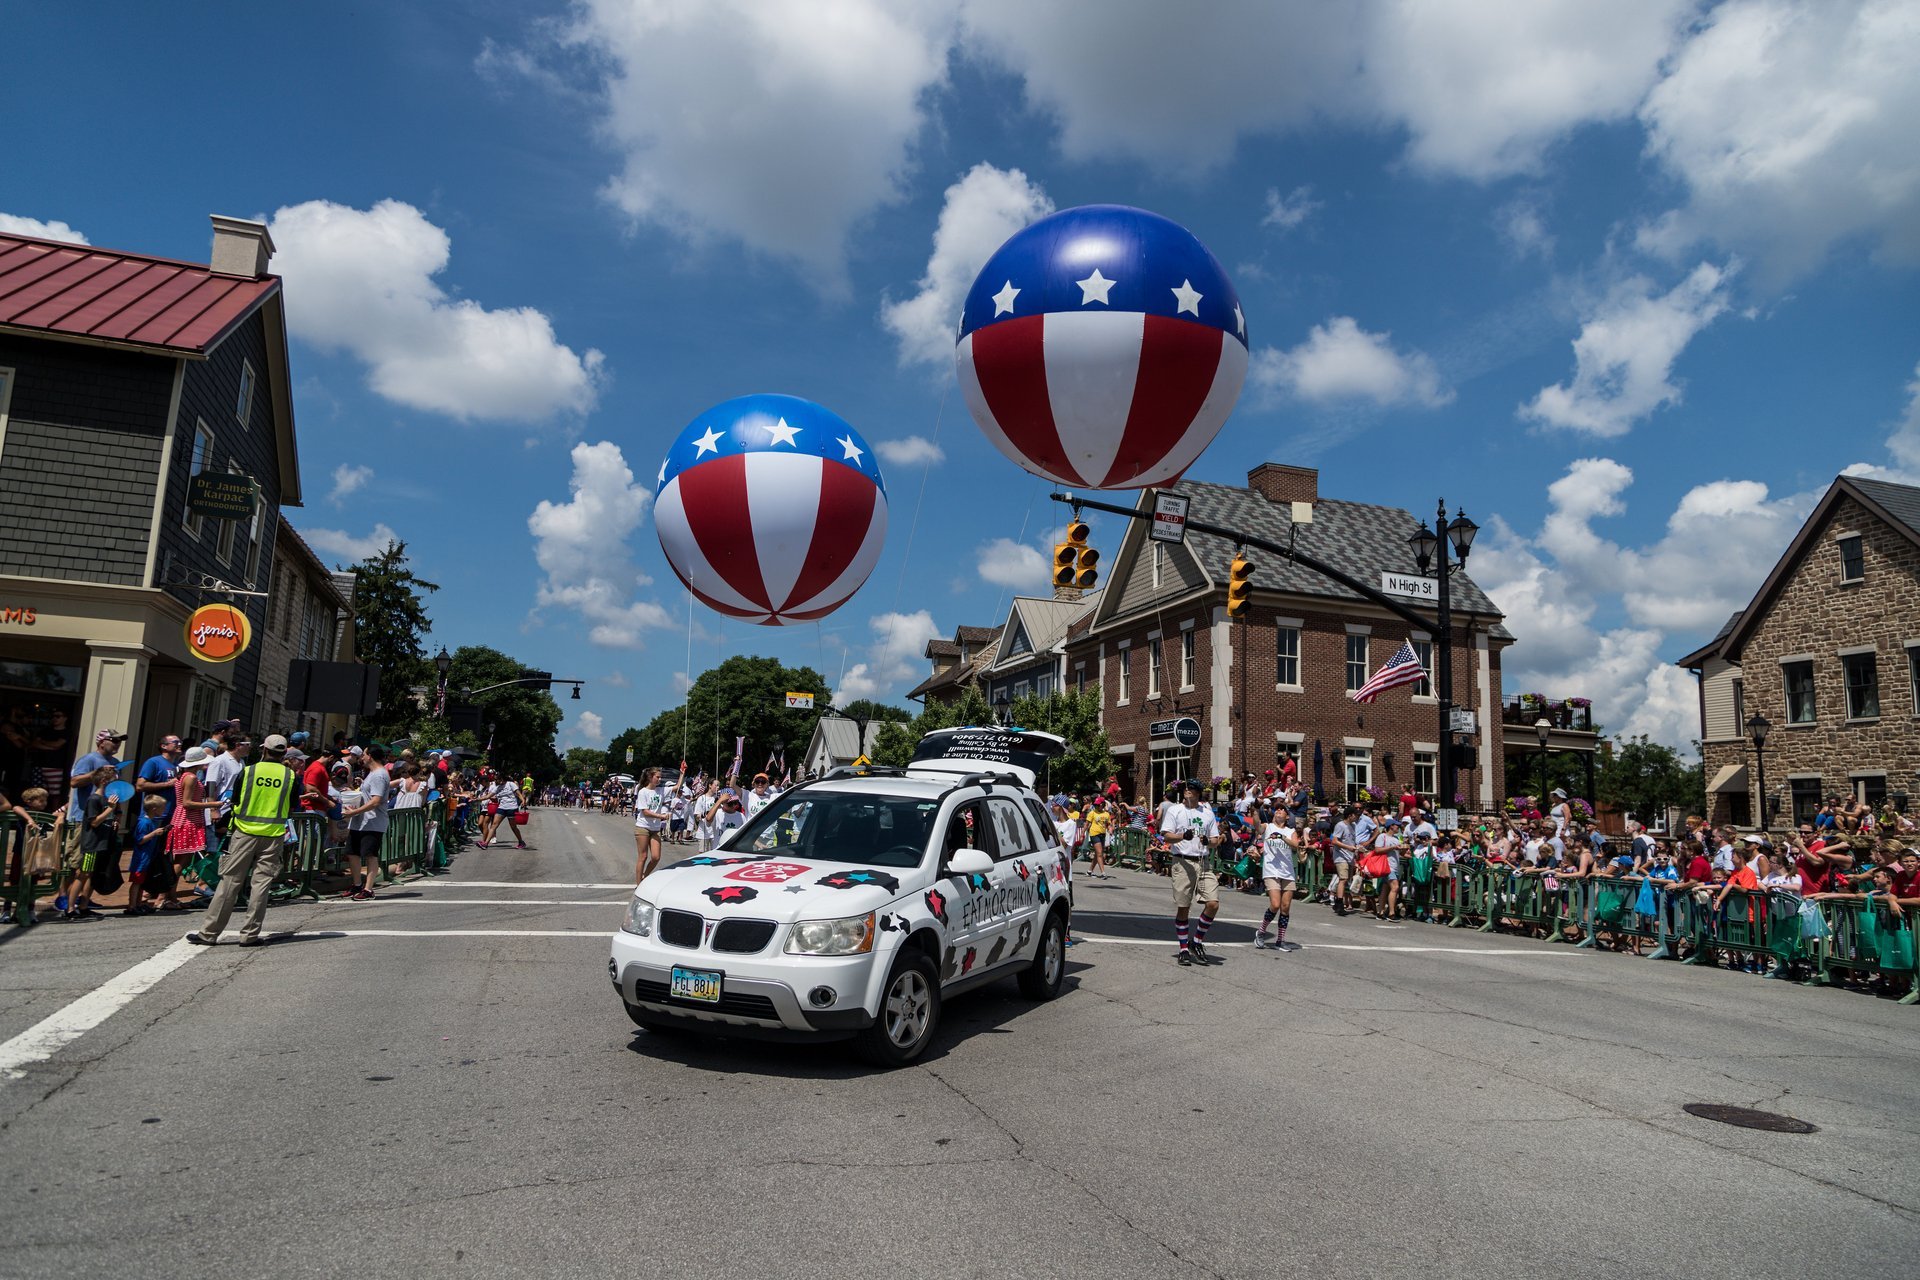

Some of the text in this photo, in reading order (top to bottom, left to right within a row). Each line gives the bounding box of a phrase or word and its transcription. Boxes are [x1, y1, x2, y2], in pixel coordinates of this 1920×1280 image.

[197, 479, 254, 495] Dr. James
[203, 490, 245, 503] Karpac
[193, 499, 250, 512] ORTHODONTIST
[1161, 514, 1179, 523] YIELD
[1152, 528, 1182, 537] PEDESTRIANS
[1389, 577, 1432, 595] N High St
[0, 607, 36, 626] MS
[998, 735, 1024, 744] (614)
[256, 776, 282, 788] CSO
[962, 883, 1034, 930] EAT MOR CHIKIN
[675, 976, 716, 995] FGL 8811
